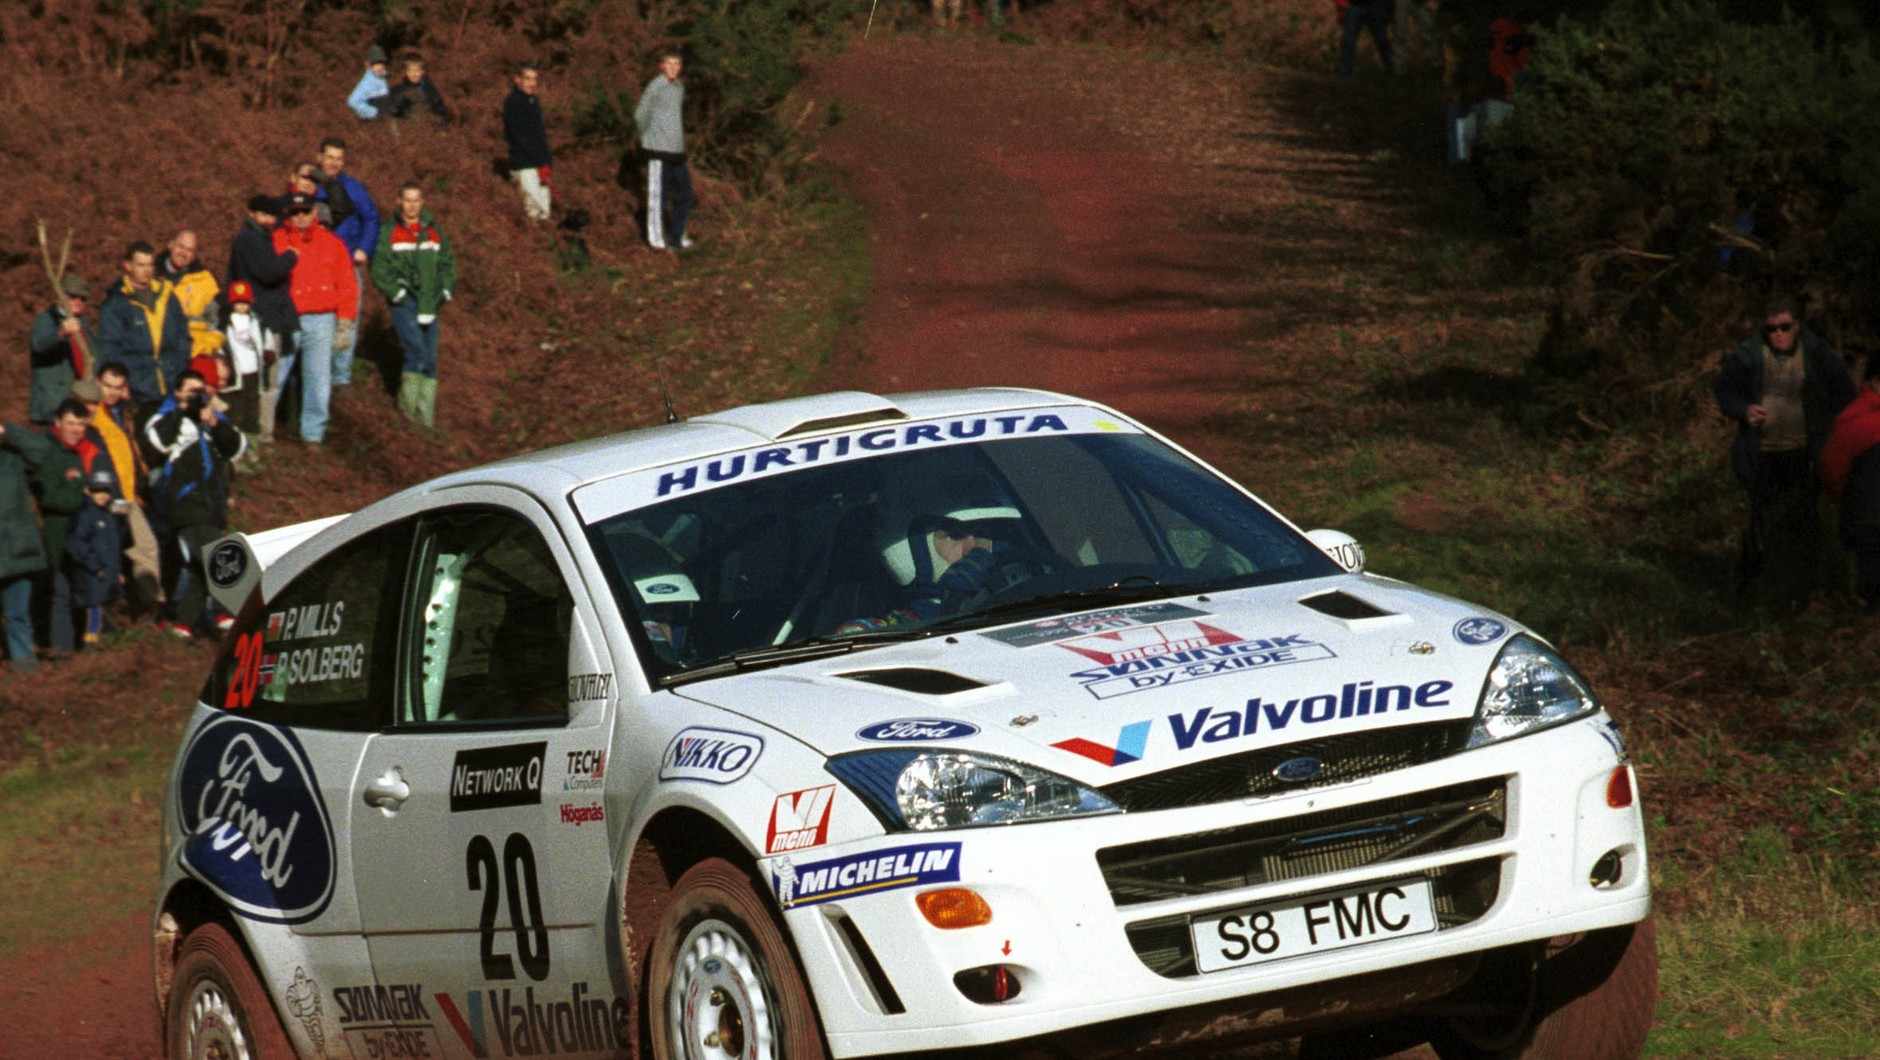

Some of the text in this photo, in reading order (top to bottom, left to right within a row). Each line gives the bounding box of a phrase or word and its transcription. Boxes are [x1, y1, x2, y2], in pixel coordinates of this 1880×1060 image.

[657, 414, 1069, 497] HURTIGRUTA
[294, 601, 344, 640] MILLS
[225, 631, 263, 709] 20
[287, 643, 365, 685] SOLBERG
[1129, 651, 1298, 688] by EXIDE
[875, 720, 956, 739] Ford
[1167, 679, 1454, 751] Valvoline
[526, 756, 541, 791] Q
[567, 750, 602, 775] TECH
[668, 737, 752, 773] NIKKO
[197, 732, 300, 888] Ford
[560, 801, 605, 827] Höganäs
[800, 849, 955, 895] MICHELIN
[466, 832, 550, 982] 20
[1217, 886, 1411, 961] S8 FMC
[488, 981, 632, 1058] Valvoline
